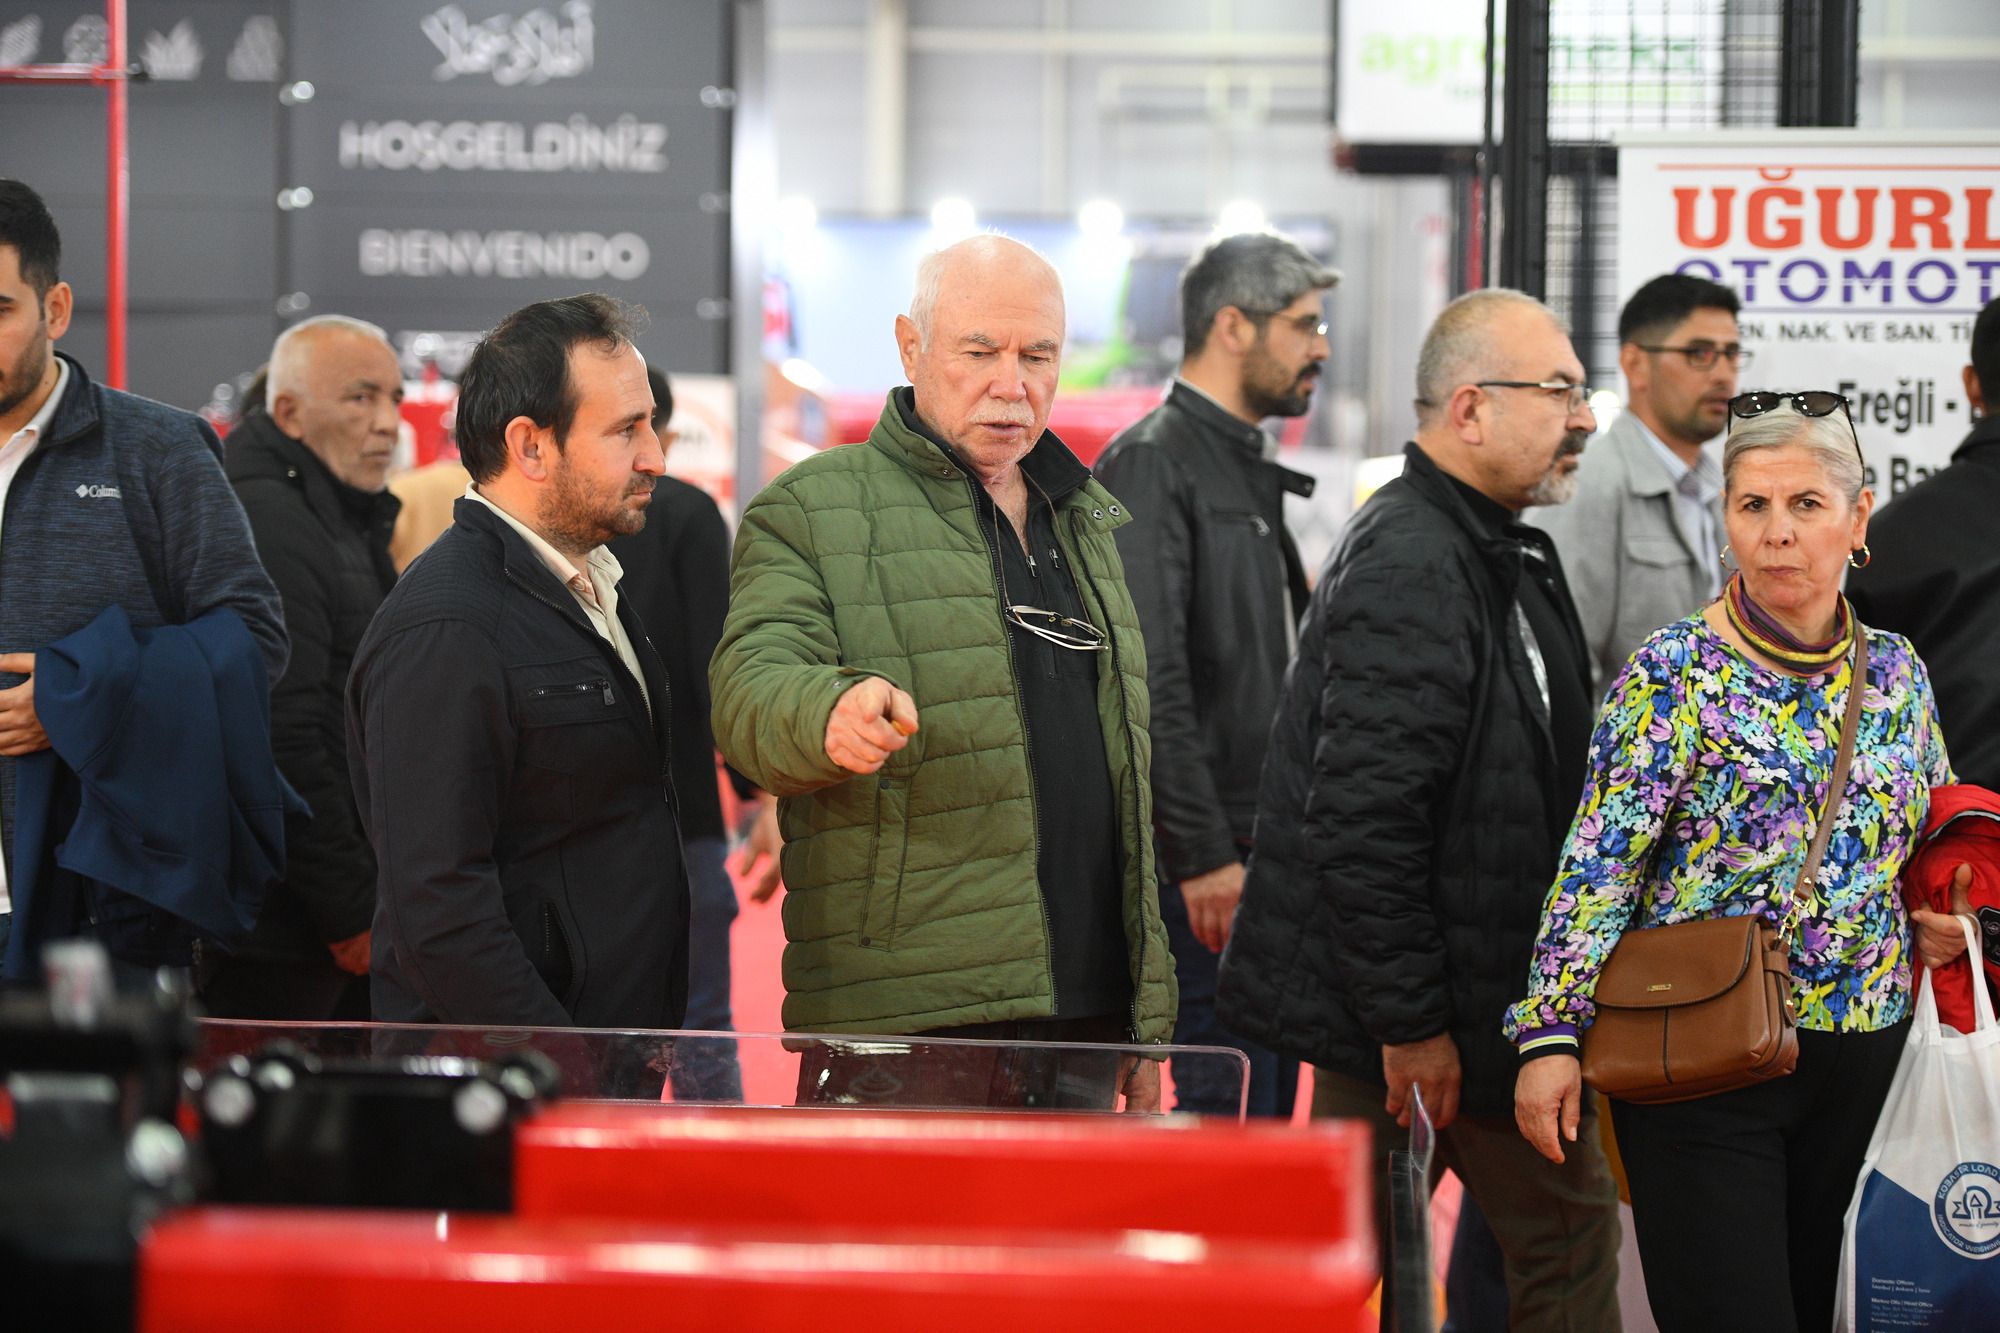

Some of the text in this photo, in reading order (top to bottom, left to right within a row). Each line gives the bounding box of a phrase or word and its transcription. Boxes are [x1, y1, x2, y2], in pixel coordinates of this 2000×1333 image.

[1673, 166, 2000, 250] UĞURL
[359, 229, 649, 280] BIENVENIDO
[1843, 321, 1876, 341] VE
[1837, 378, 1936, 434] Ereğli
[1970, 1164, 1998, 1177] LOAD
